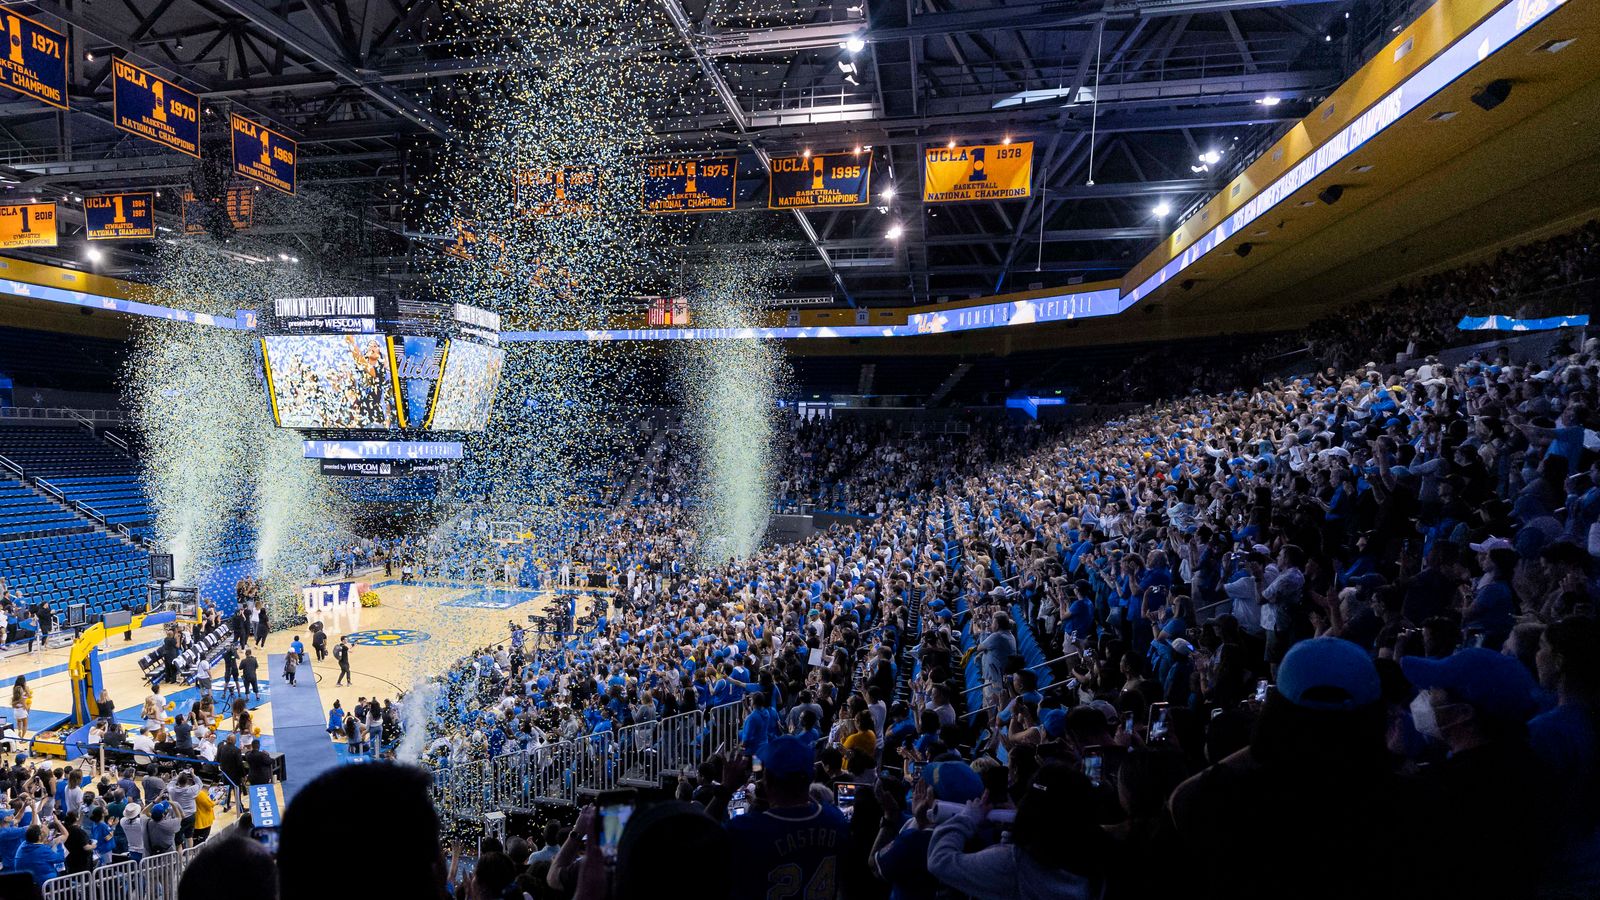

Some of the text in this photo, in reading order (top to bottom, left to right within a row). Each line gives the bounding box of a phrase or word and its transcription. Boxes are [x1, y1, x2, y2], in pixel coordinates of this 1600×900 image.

[31, 31, 60, 59] 1971
[12, 72, 60, 101] CHAMPIONS
[115, 62, 148, 89] UCLA
[170, 99, 196, 122] 1970
[142, 115, 176, 134] BASKETBALL
[122, 116, 195, 152] NATIONAL CHAMPIONS
[233, 117, 257, 138] UCLA
[273, 146, 293, 165] 1969
[929, 149, 968, 162] UCLA
[997, 148, 1022, 159] 1978
[649, 163, 685, 177] UCLA
[703, 165, 728, 177] 1975
[773, 158, 809, 172] UCLA
[831, 166, 860, 179] 1995
[796, 189, 841, 197] BASKETBALL
[953, 182, 998, 190] BASKETBALL
[778, 194, 858, 206] NATIONAL CHAMPIONS
[928, 188, 1026, 200] NATIONAL CHAMPIONS
[86, 197, 111, 208] UCLA
[649, 198, 727, 208] NATIONAL CHAMPIONS
[35, 212, 52, 220] 2018
[118, 228, 150, 236] CHAMPIONS
[275, 299, 299, 317] EDWIN
[308, 298, 336, 316] PAULEY
[337, 296, 375, 315] PAVILION
[288, 318, 361, 329] presented by WESCOM
[347, 463, 378, 471] WESCOM
[302, 582, 361, 612] UCLA
[775, 828, 837, 857] CASTRO
